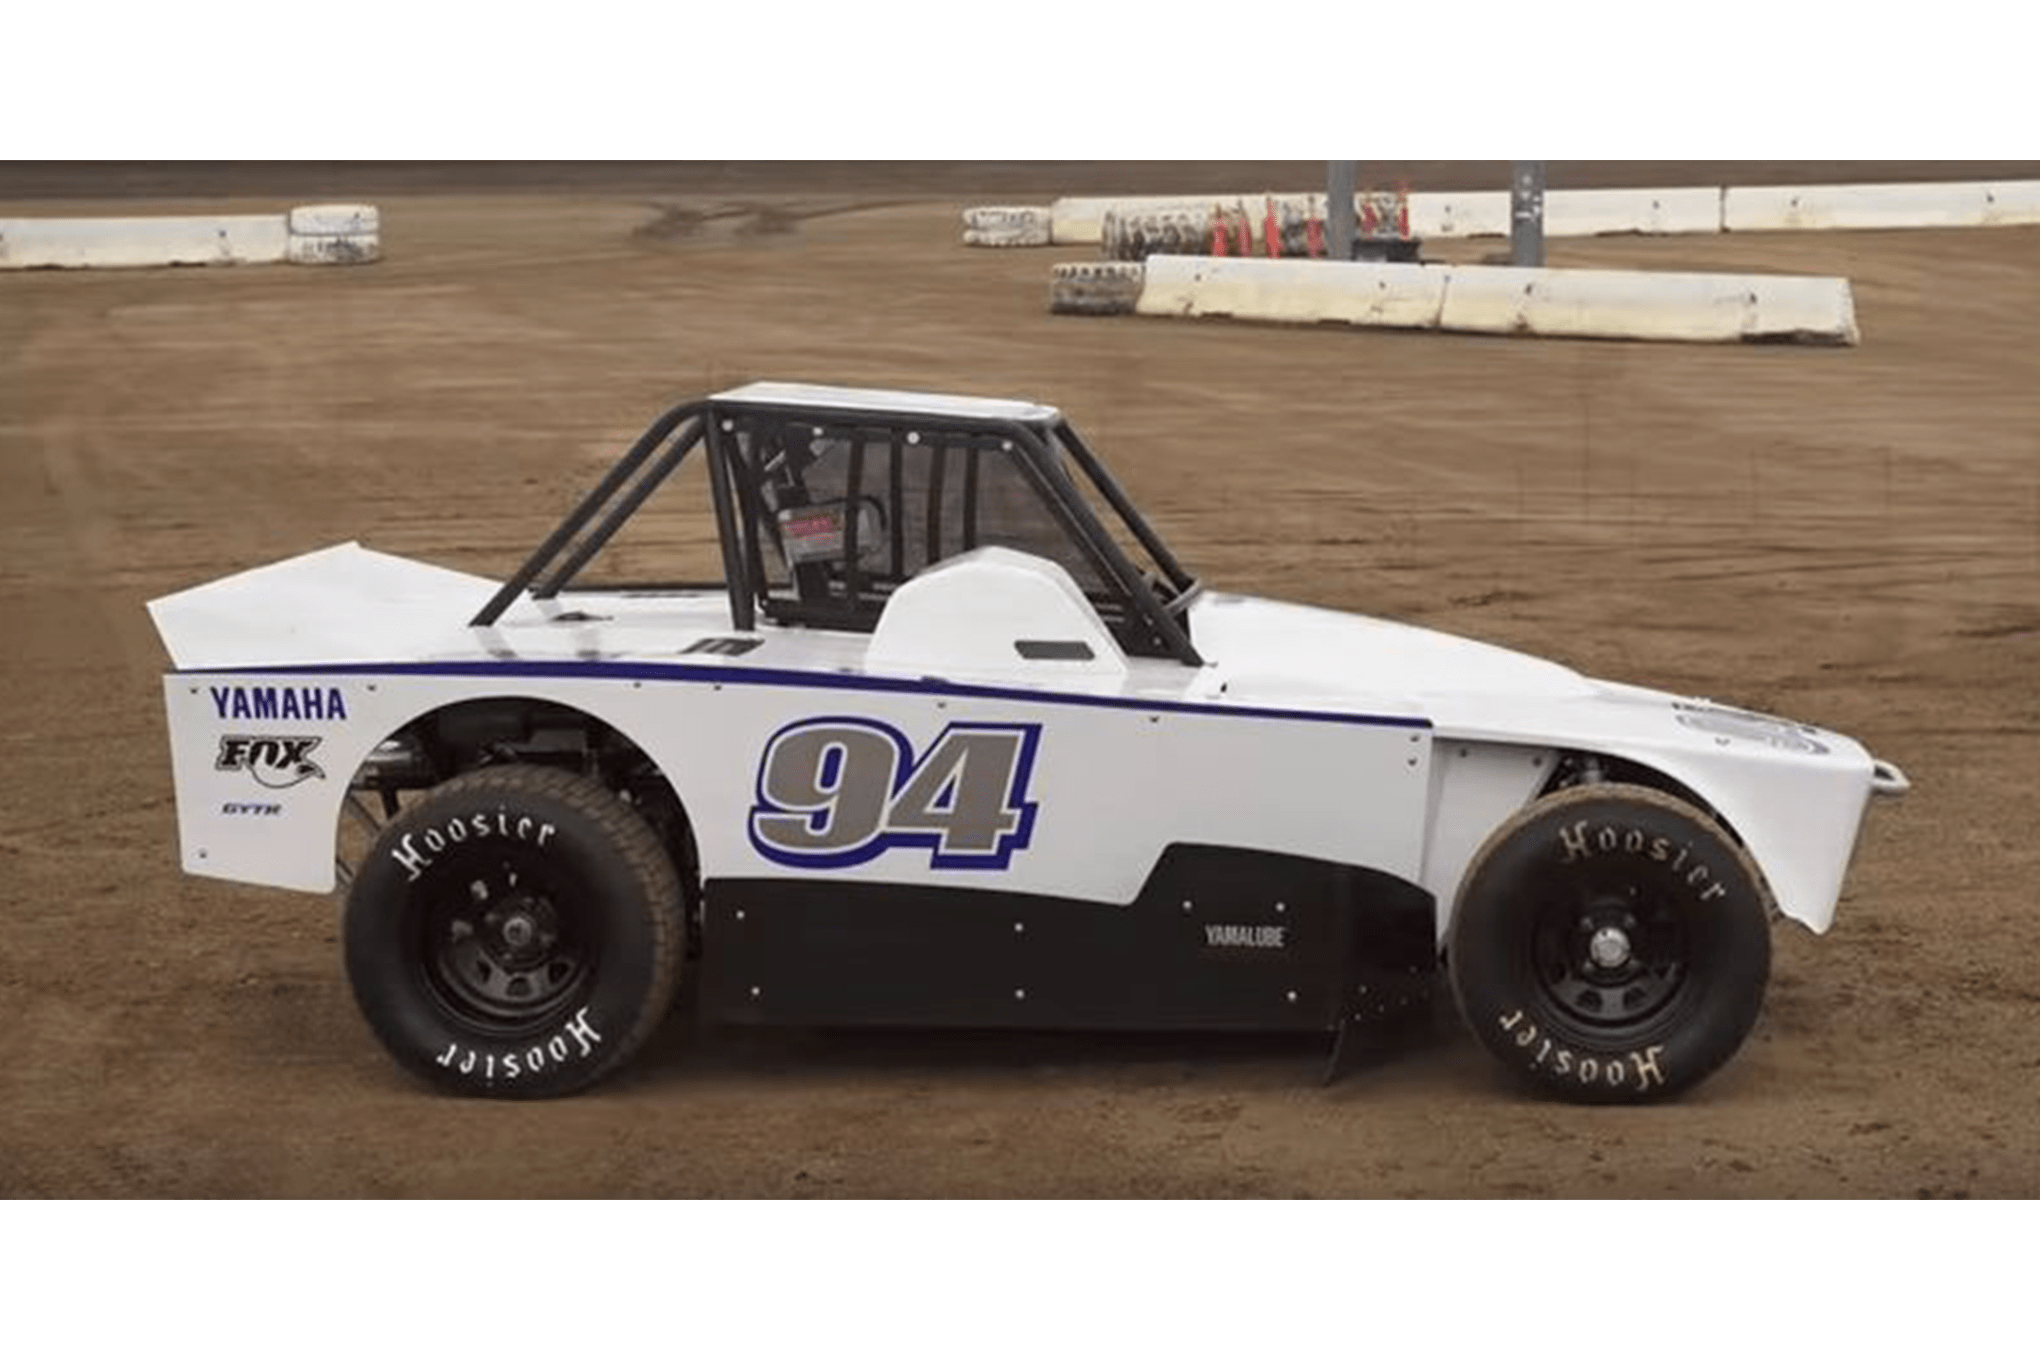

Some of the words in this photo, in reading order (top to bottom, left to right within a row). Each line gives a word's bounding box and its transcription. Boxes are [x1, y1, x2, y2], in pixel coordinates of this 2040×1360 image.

[211, 685, 347, 720] YAMAHA
[216, 735, 322, 775] FOX
[748, 716, 1042, 870] 94
[391, 805, 556, 882] Hoosier
[1559, 820, 1726, 902] Hoosier
[1205, 924, 1285, 947] YAMALUBE
[437, 1007, 602, 1086] Hoosier
[1500, 1009, 1666, 1088] Hoosier
